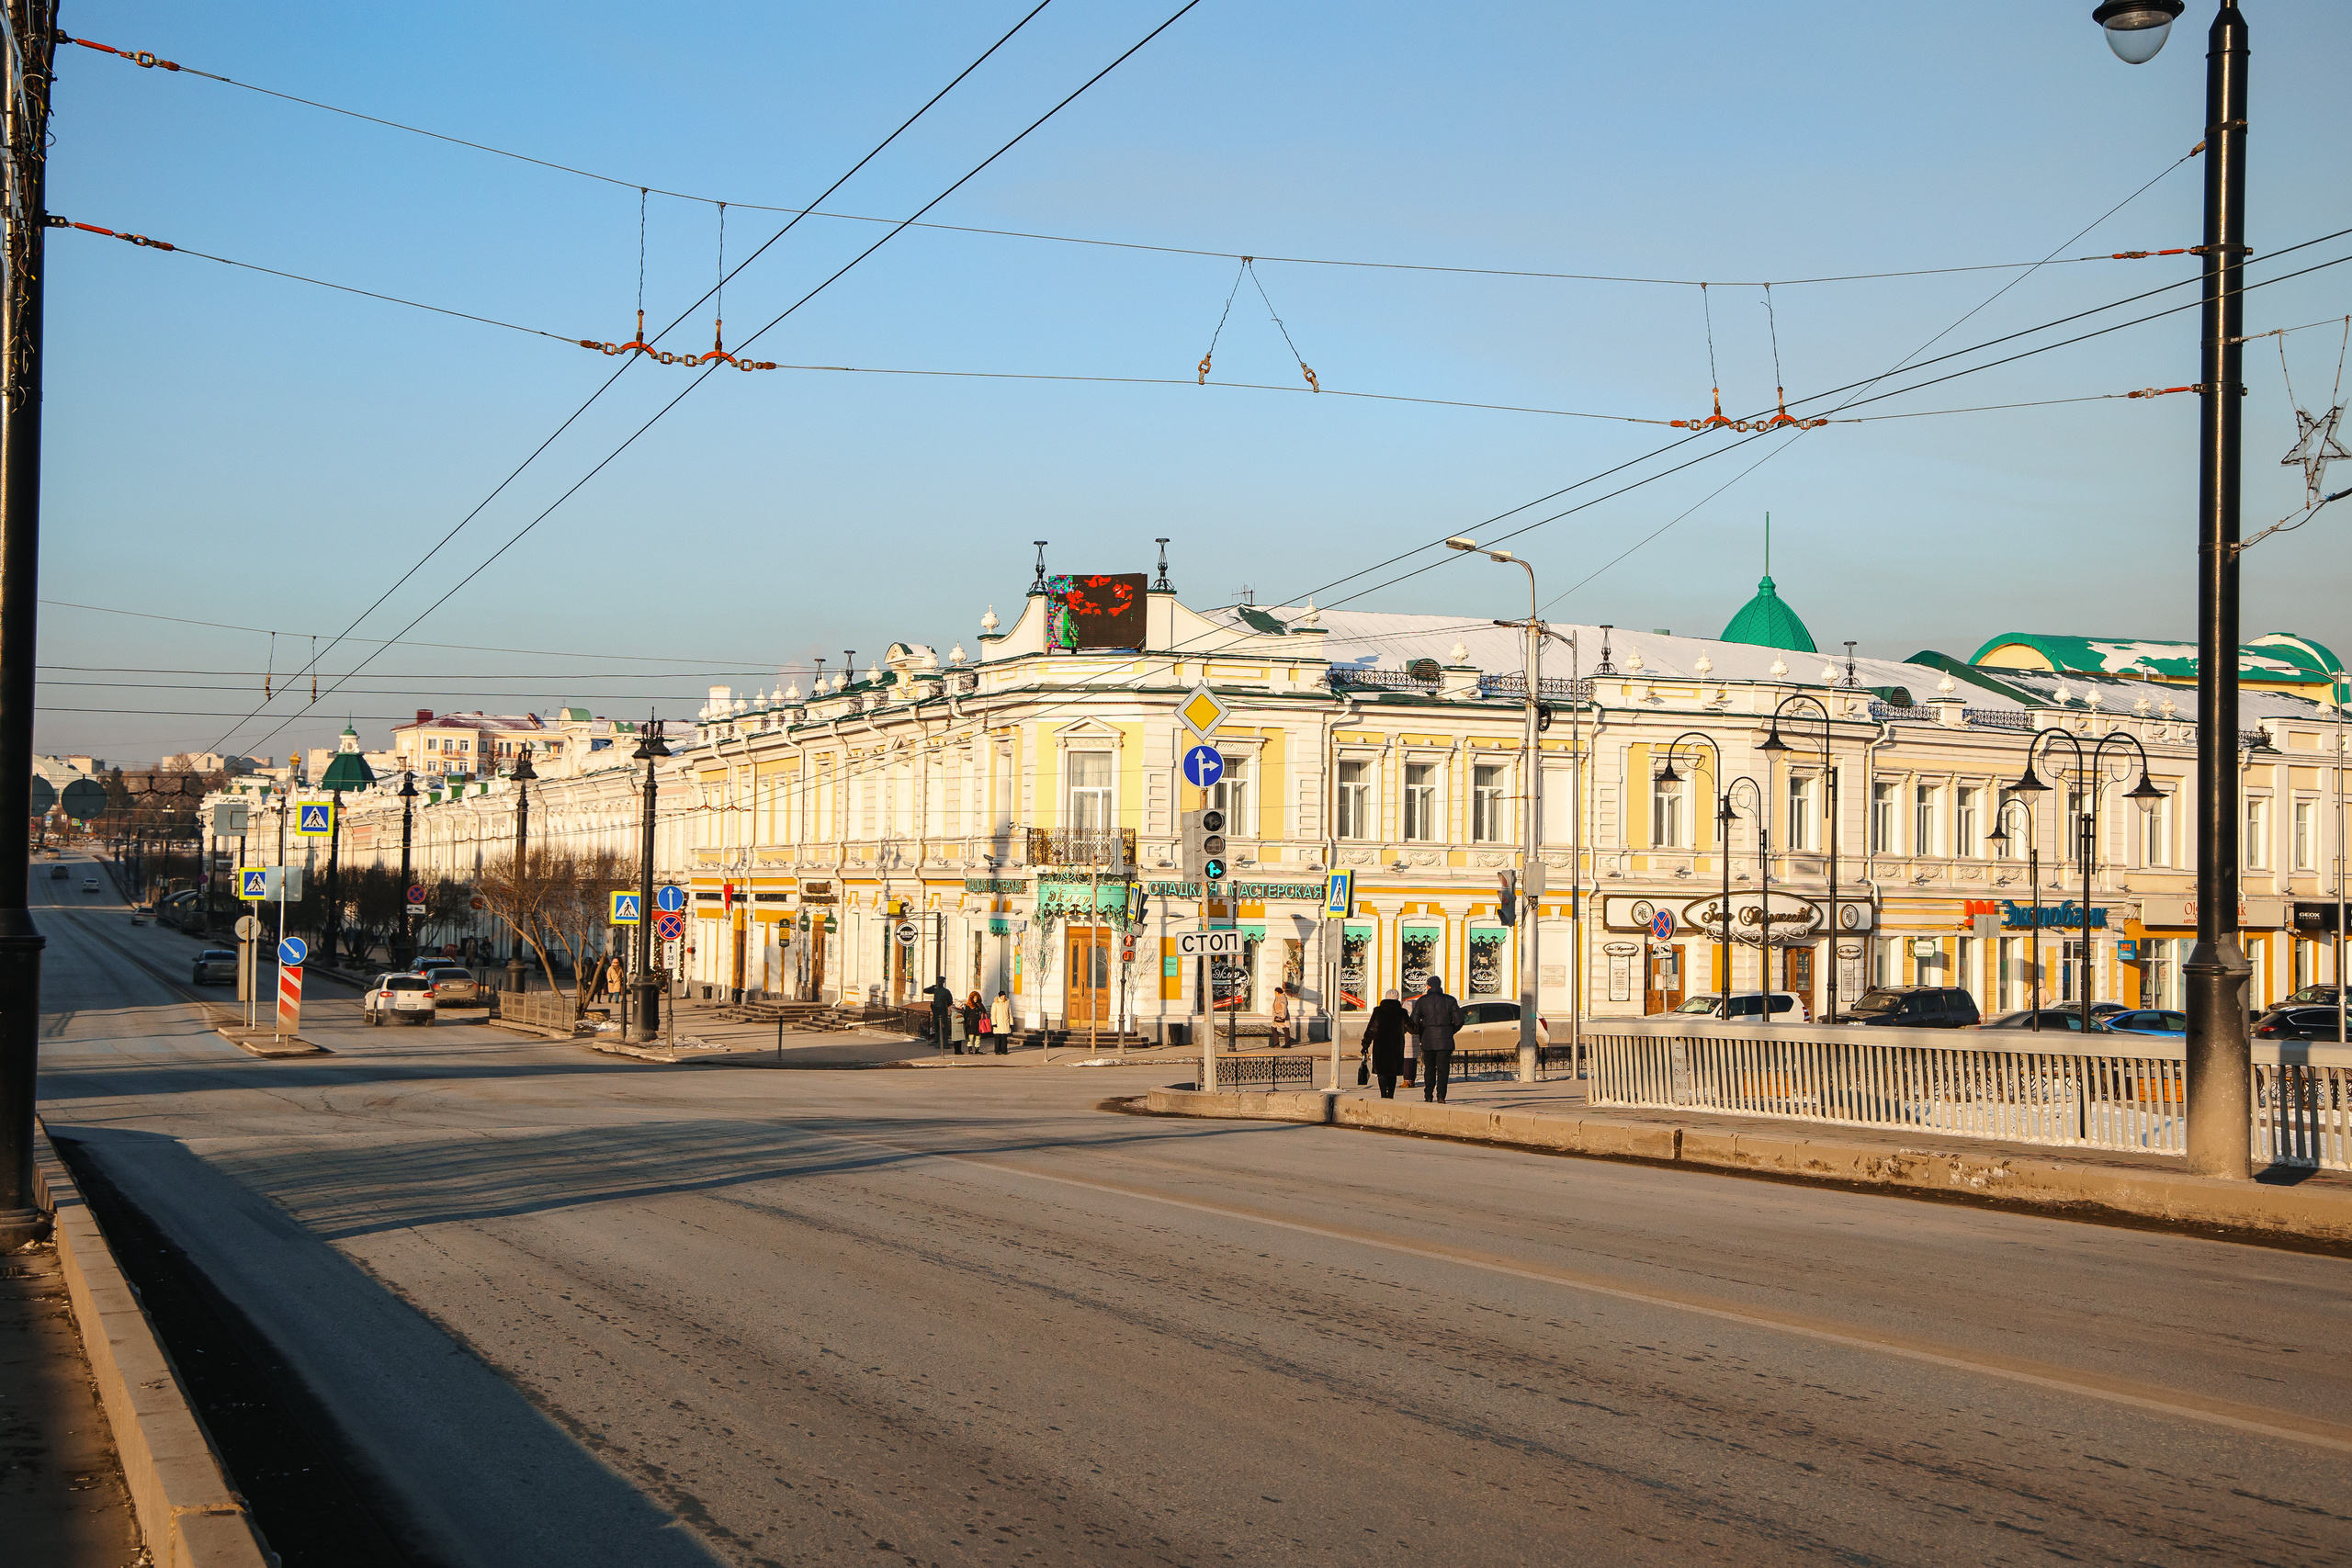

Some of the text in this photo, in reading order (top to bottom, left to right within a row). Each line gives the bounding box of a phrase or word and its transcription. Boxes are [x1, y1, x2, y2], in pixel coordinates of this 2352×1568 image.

[1047, 889, 1091, 905] Эклер
[2002, 899, 2108, 926] Экспобанк
[1182, 933, 1238, 952] СТОП
[1212, 967, 1239, 979] Эклр
